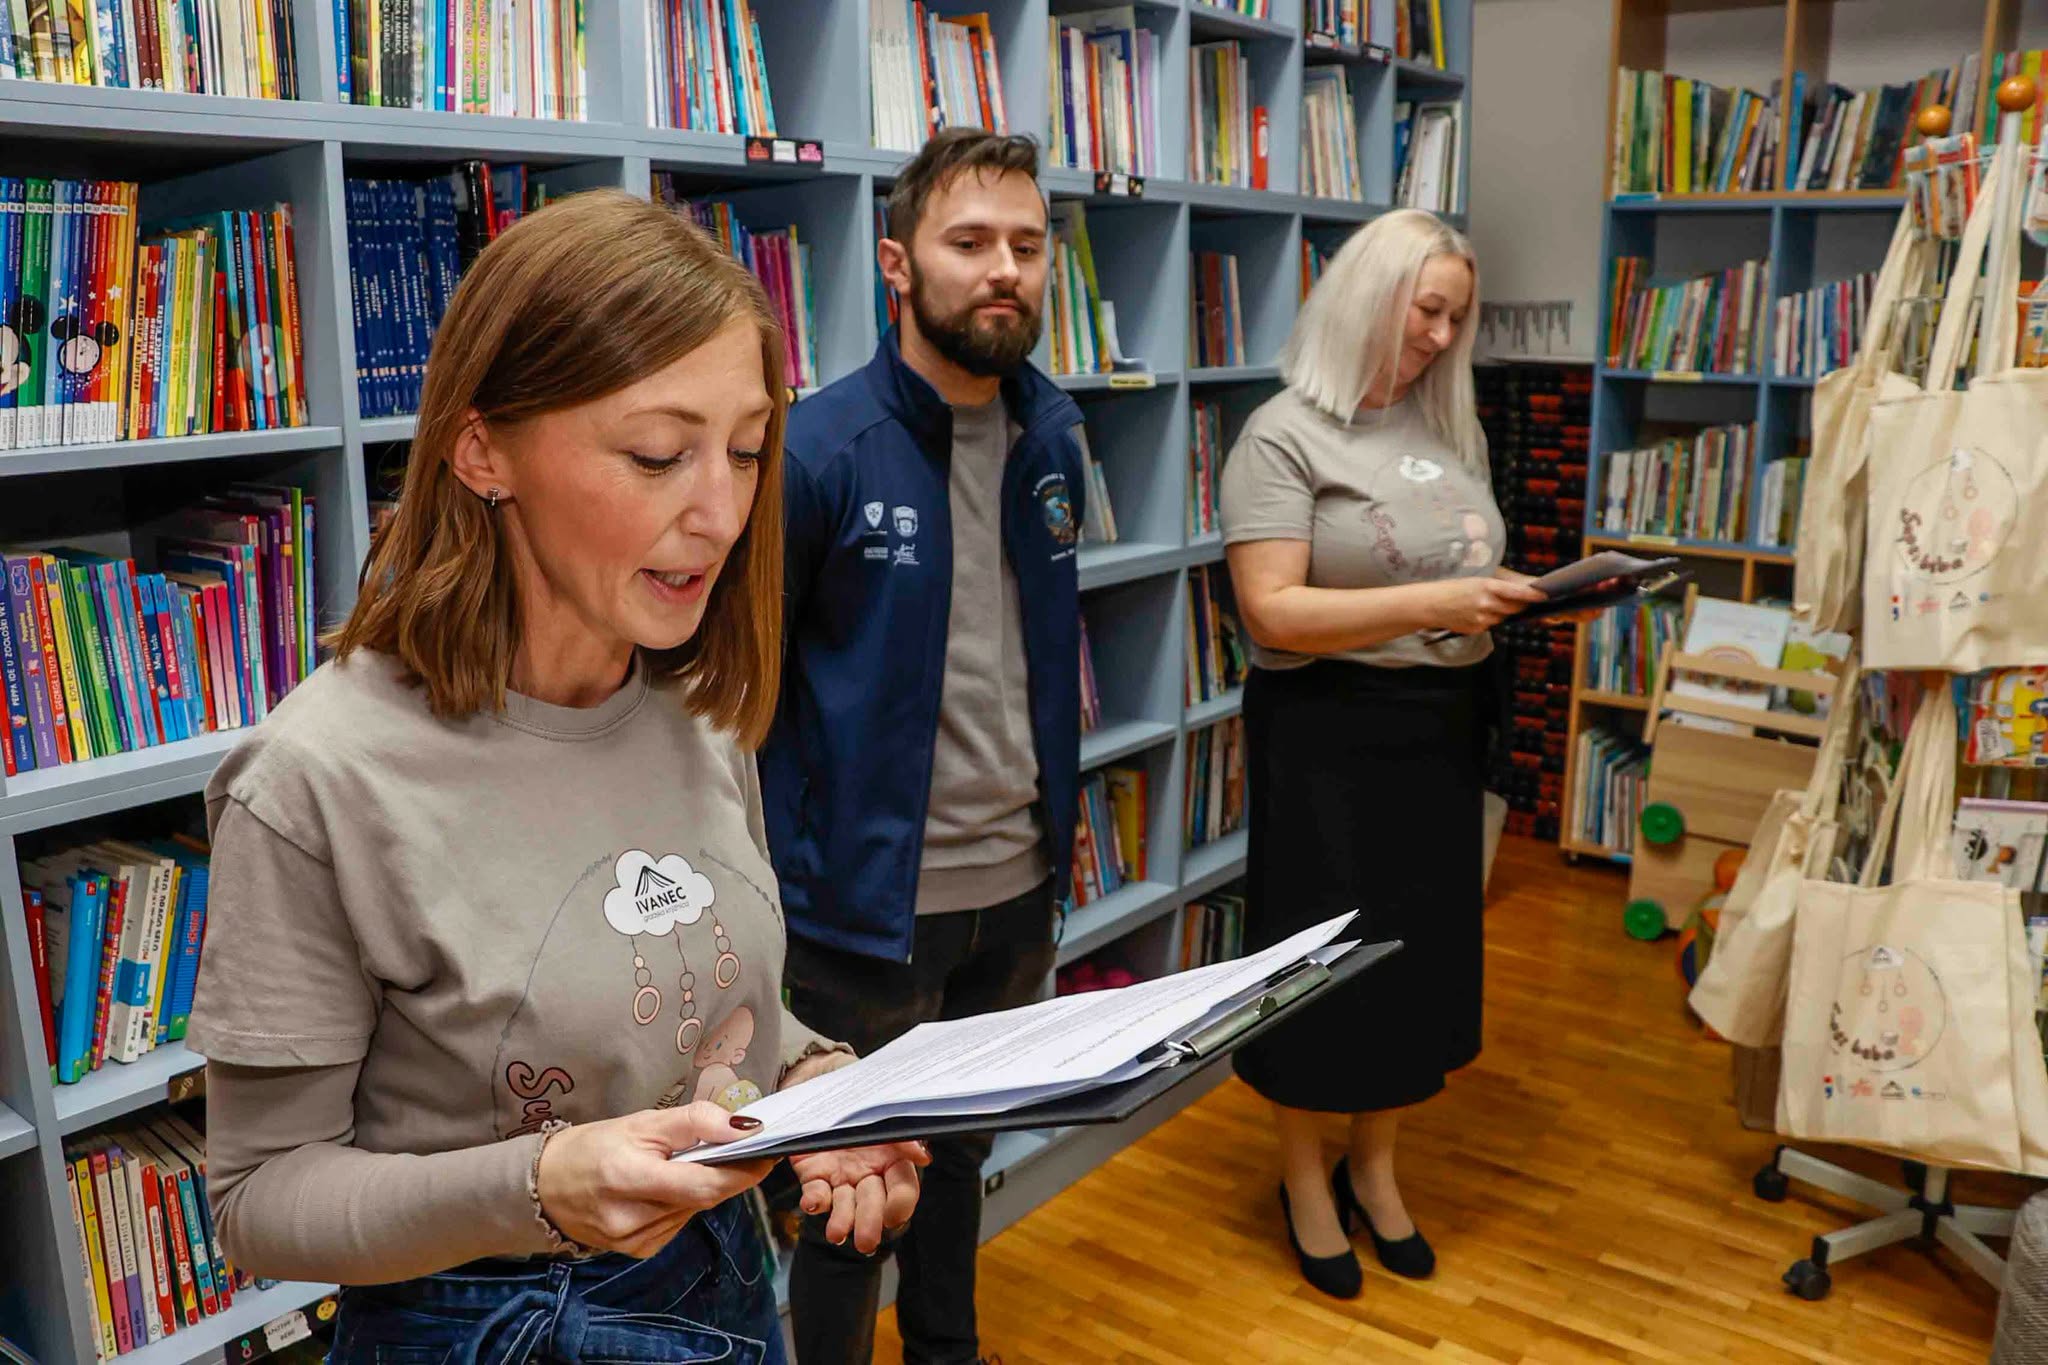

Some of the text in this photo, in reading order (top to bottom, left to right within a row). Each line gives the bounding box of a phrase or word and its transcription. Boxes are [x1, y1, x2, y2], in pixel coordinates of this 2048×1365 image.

[136, 341, 143, 351] NA
[148, 317, 156, 355] BALONOM
[134, 354, 142, 390] KRALJICA
[154, 337, 162, 382] DOKTORICA
[0, 618, 13, 658] ZOOLOŠKI
[8, 667, 17, 682] IDE
[153, 652, 162, 670] Moj
[10, 682, 20, 706] PEPPA
[52, 680, 63, 710] GEORGE
[635, 886, 687, 915] IVANEC
